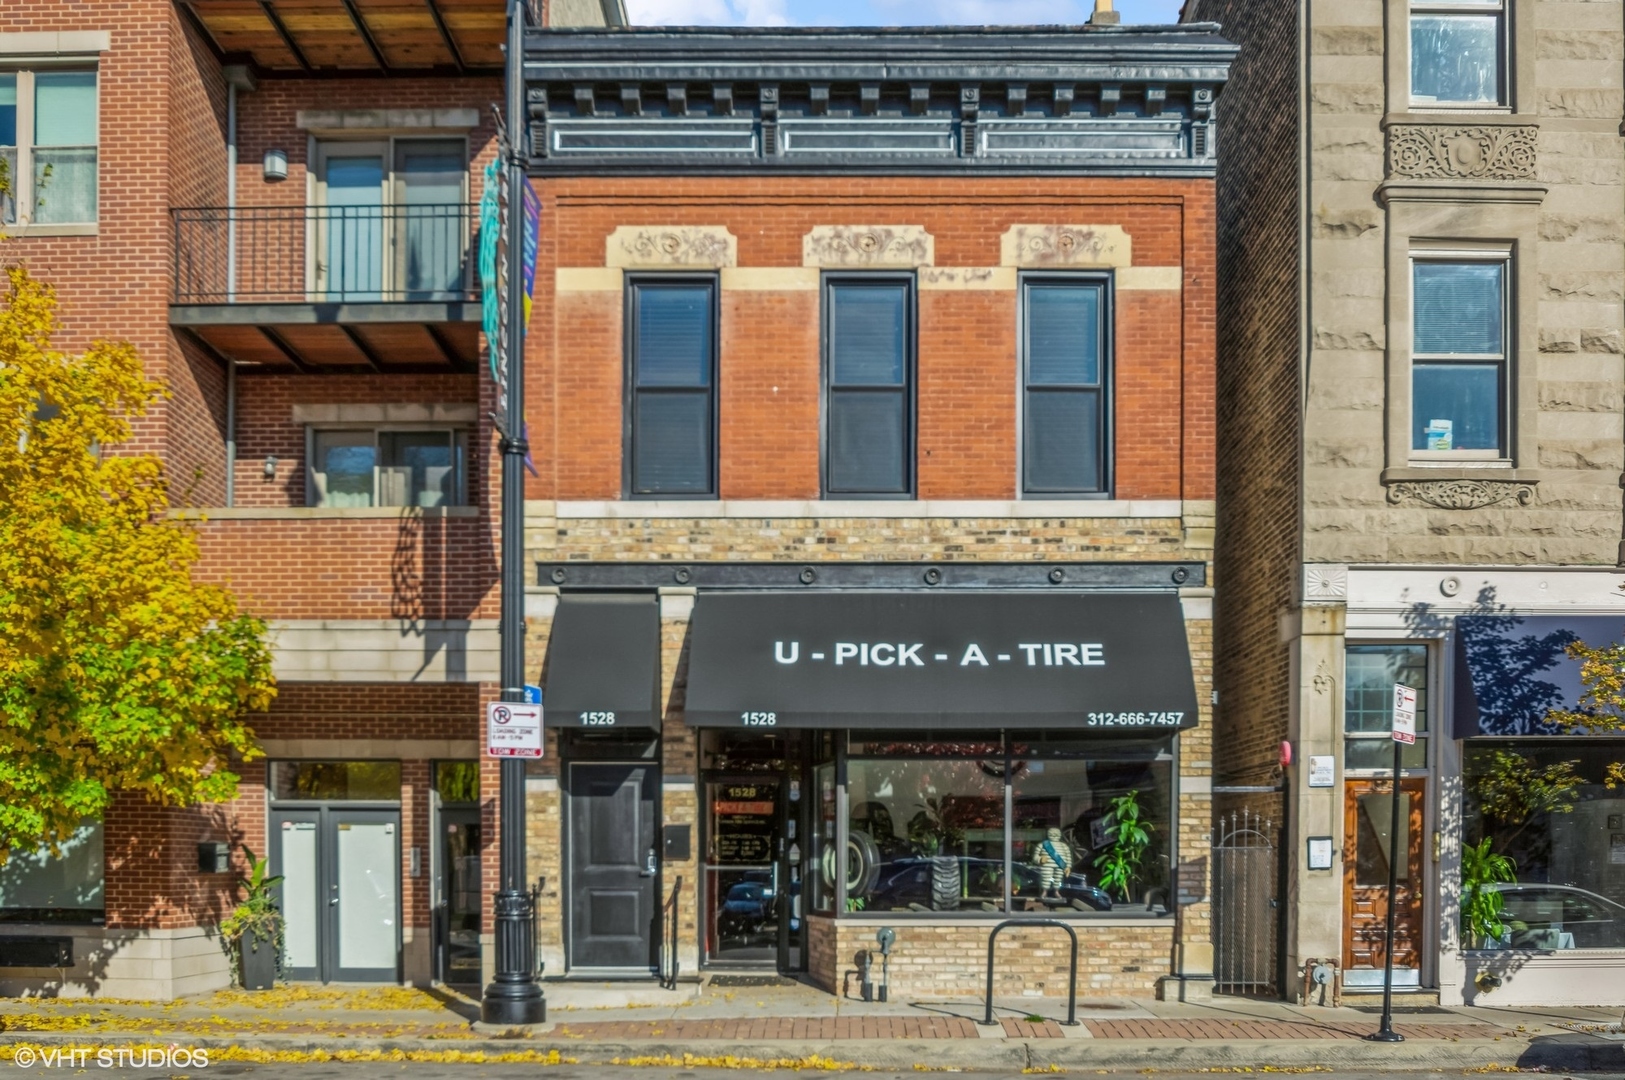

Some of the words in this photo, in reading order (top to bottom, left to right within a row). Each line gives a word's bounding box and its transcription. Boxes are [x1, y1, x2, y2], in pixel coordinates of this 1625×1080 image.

[775, 642, 798, 664] U
[836, 643, 924, 666] PICK
[960, 644, 989, 666] A
[1019, 644, 1105, 666] TIRE
[580, 712, 615, 725] 1528
[741, 712, 776, 725] 1528
[1087, 712, 1184, 725] 312-666-7457
[493, 747, 510, 755] TOW
[514, 748, 537, 756] ZONE
[728, 787, 757, 797] 1528
